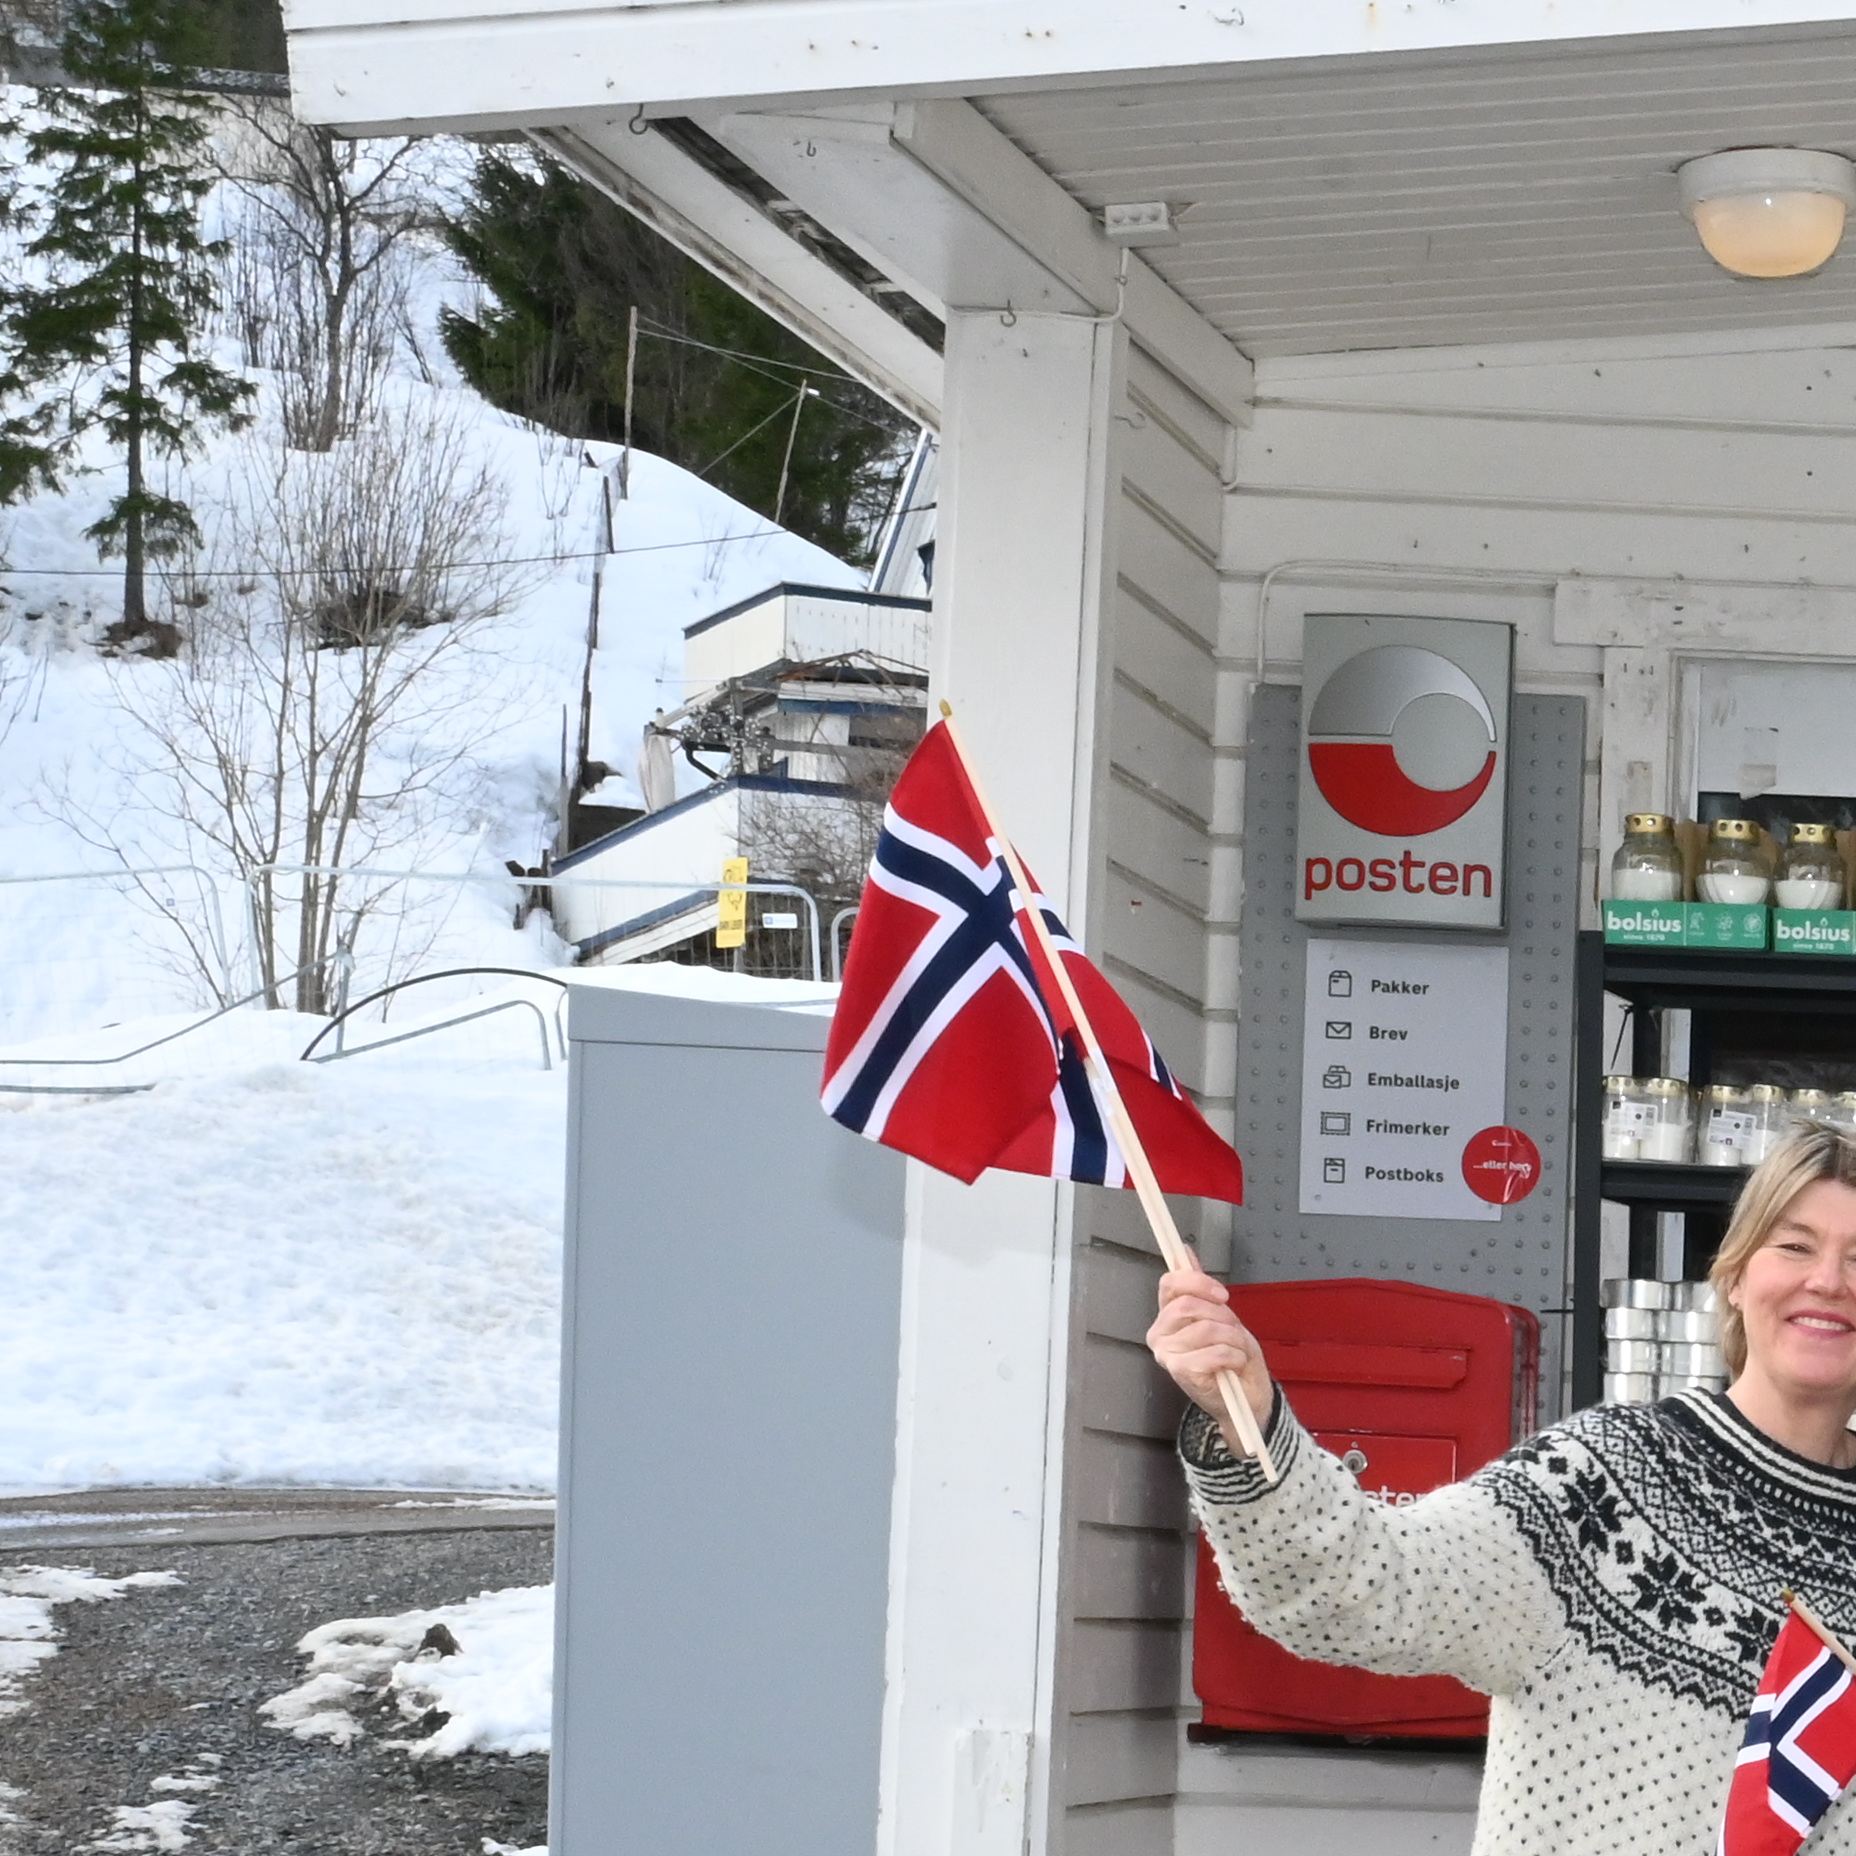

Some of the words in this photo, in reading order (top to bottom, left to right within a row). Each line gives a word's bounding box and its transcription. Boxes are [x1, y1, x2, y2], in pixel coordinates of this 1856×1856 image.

[1304, 850, 1493, 900] posten
[1606, 908, 1682, 933] bolsius
[1776, 917, 1850, 942] bolsius
[1371, 979, 1430, 995] Pakker
[1369, 1026, 1409, 1041] Brev
[1367, 1073, 1460, 1093] Emballasje
[1366, 1119, 1451, 1137] Frimerker
[1365, 1166, 1445, 1184] Postboks
